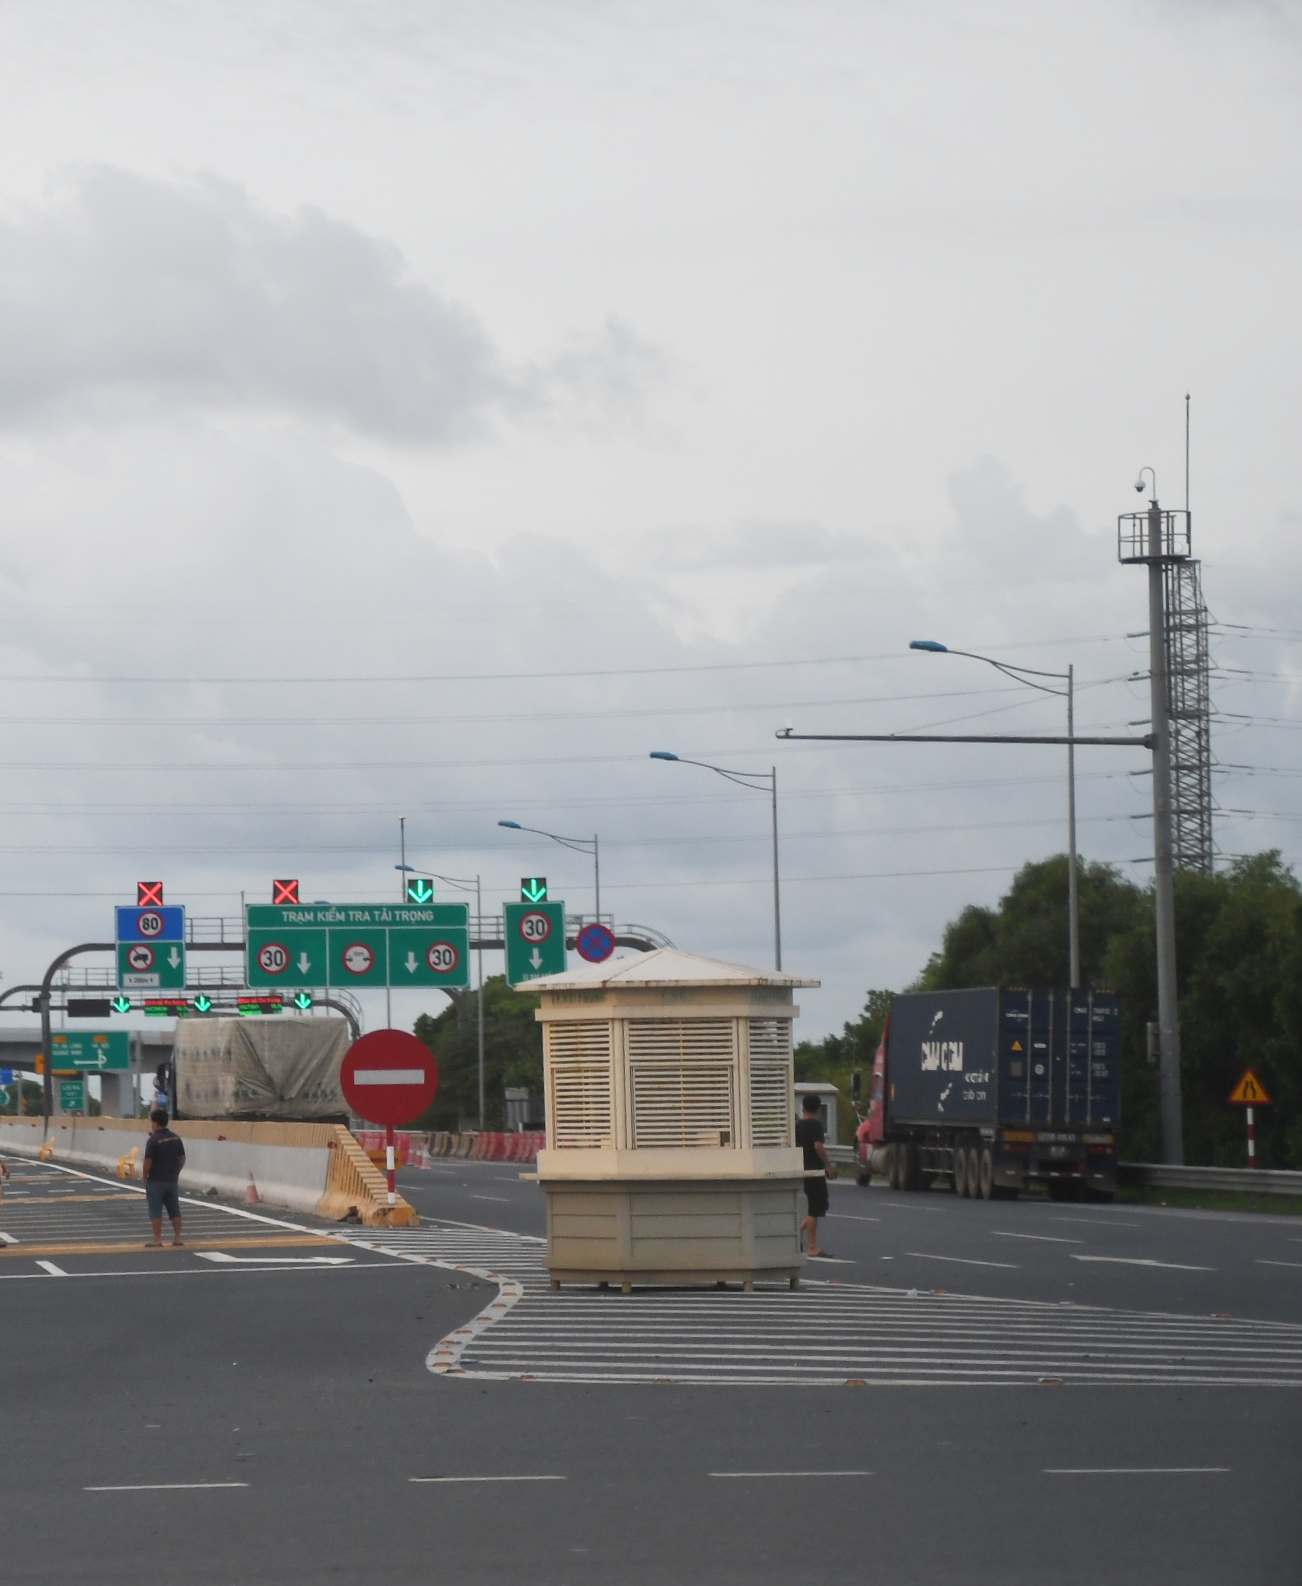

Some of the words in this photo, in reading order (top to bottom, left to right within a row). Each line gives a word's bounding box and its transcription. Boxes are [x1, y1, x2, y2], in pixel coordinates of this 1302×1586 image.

[142, 917, 159, 931] 80
[282, 911, 314, 925] TRẠM
[317, 906, 345, 922] KIỂM
[348, 911, 371, 922] TRA
[373, 907, 392, 922] TẢI
[394, 911, 434, 925] TRỌNG
[525, 919, 545, 937] 30
[263, 950, 284, 967] 30
[432, 949, 453, 966] 30
